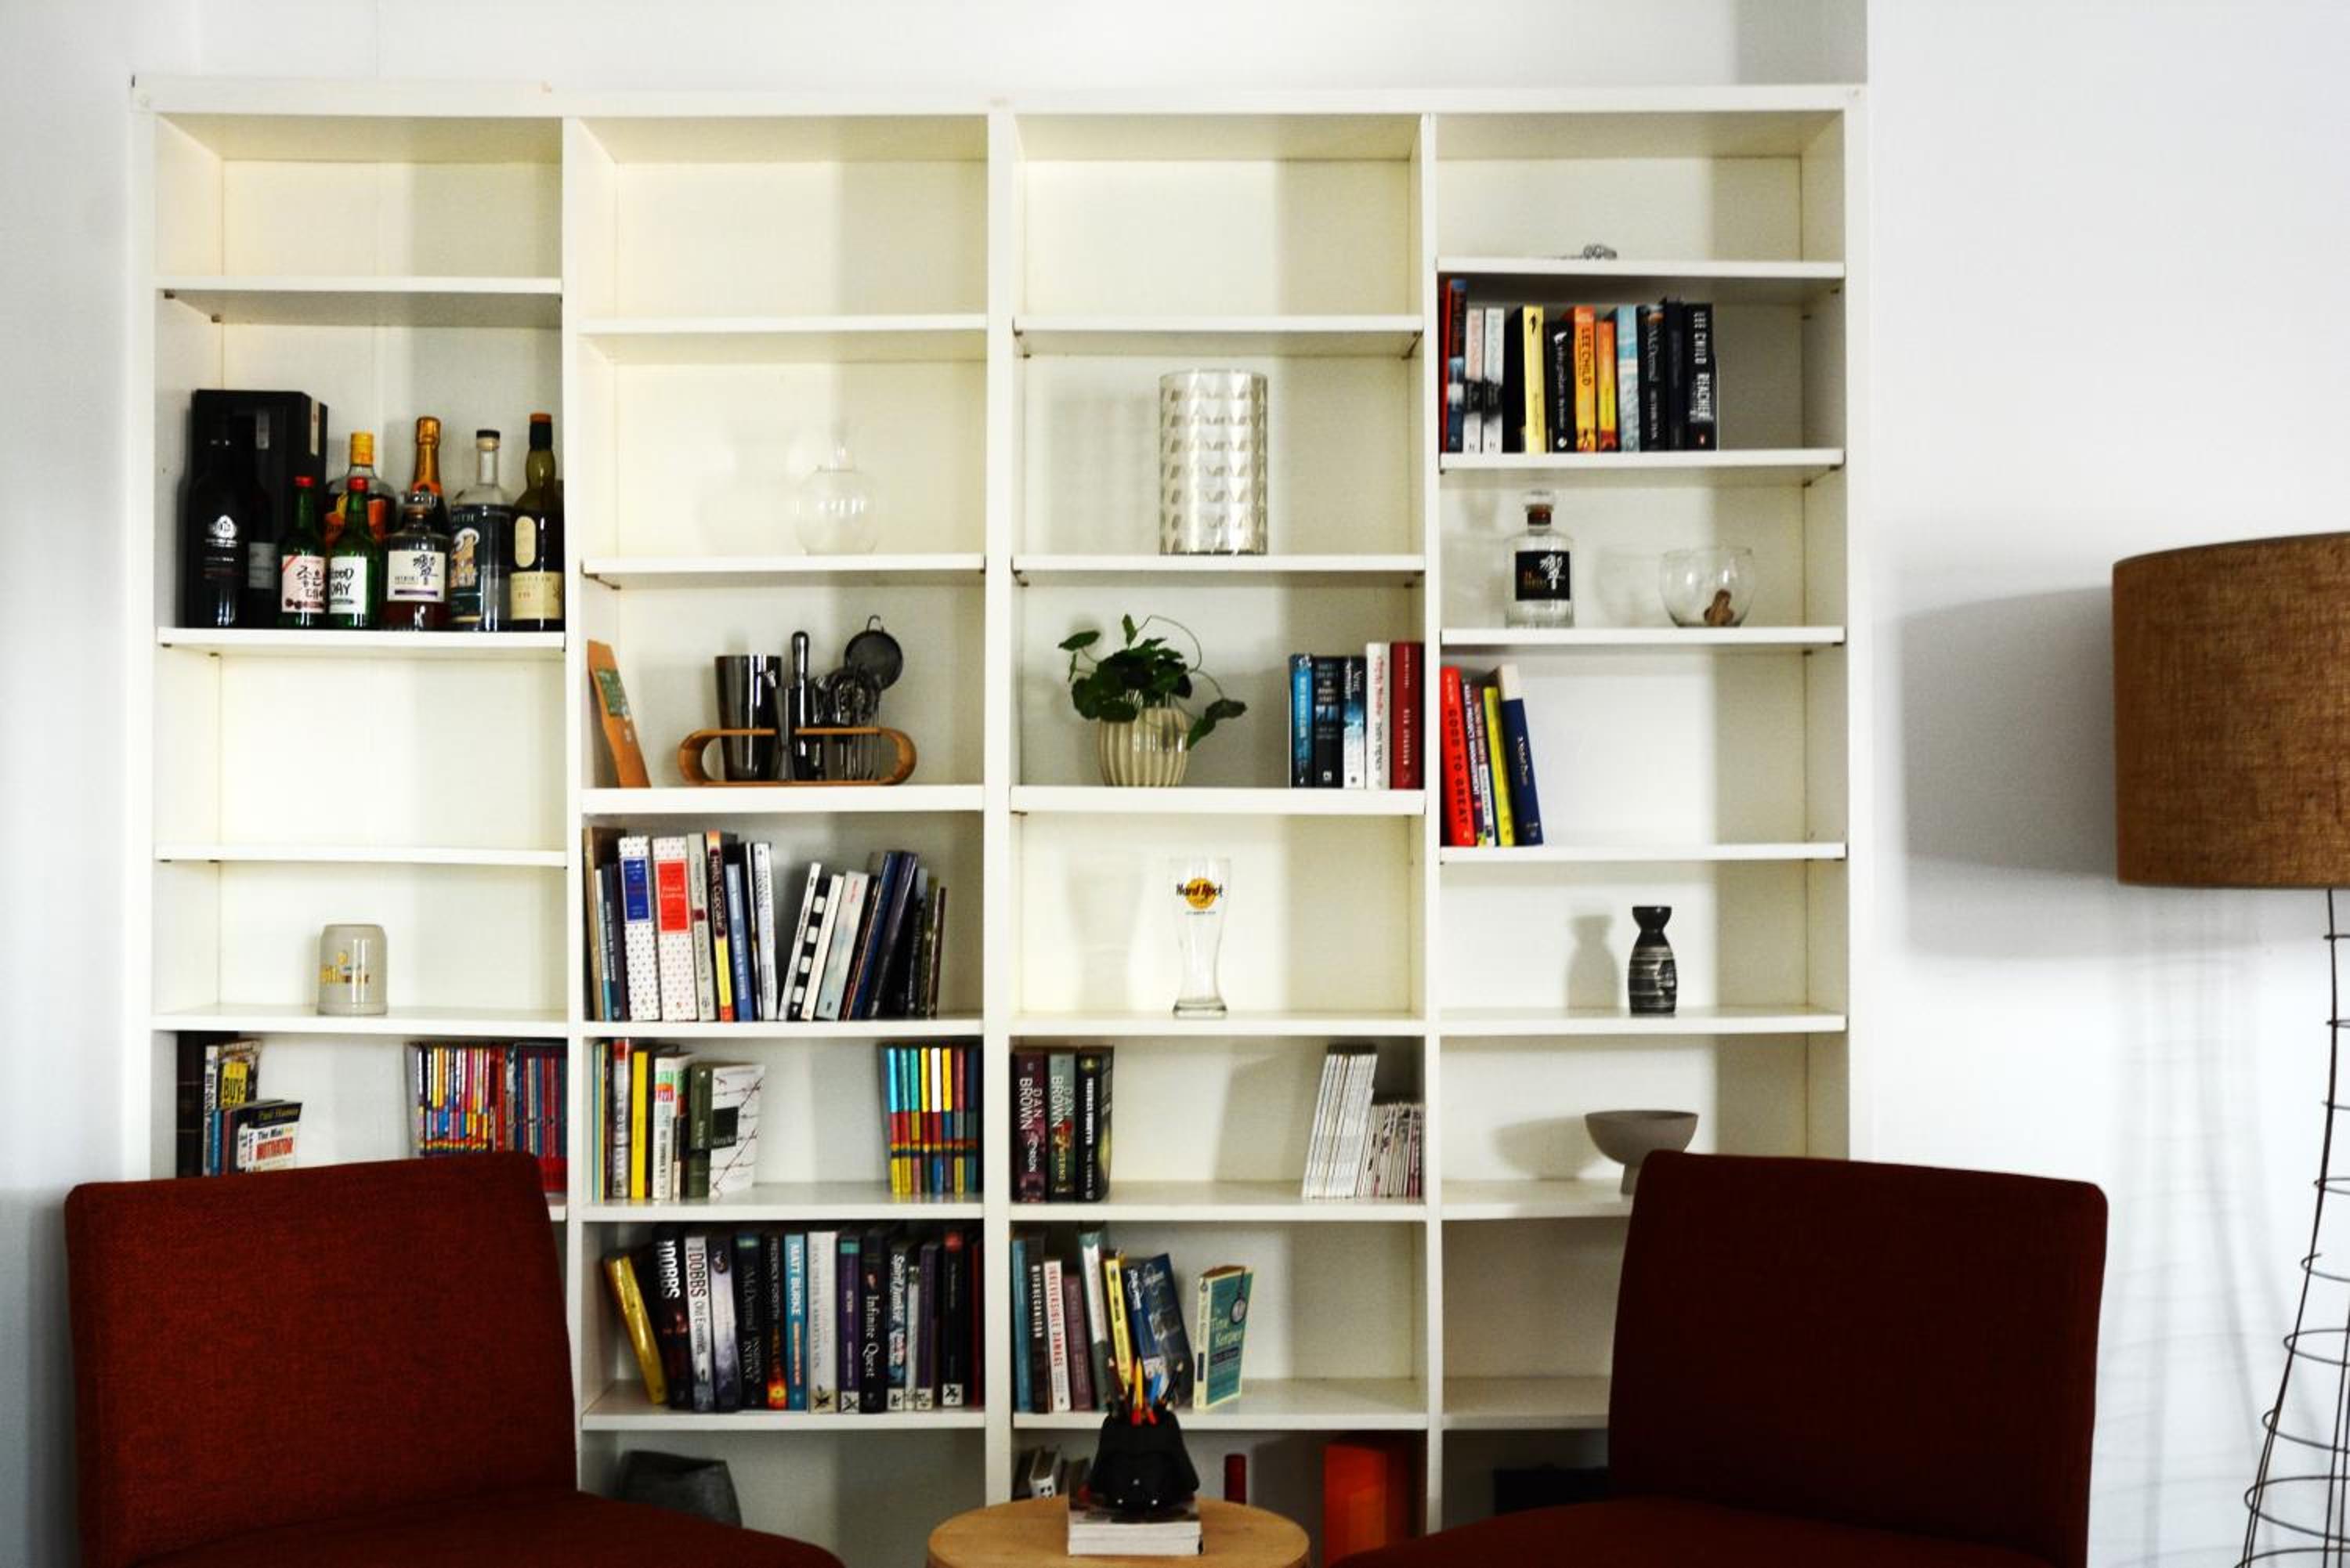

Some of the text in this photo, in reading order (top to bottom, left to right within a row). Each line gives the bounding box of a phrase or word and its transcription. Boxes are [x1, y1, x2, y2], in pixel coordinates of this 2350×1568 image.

[1581, 327, 1593, 386] LEE CHILD
[1693, 312, 1708, 364] LEE CHILD
[1447, 708, 1459, 748] GOOD
[1452, 754, 1462, 772] TO
[1455, 779, 1468, 826] GREAT
[1176, 883, 1200, 897] Hard
[1019, 1077, 1034, 1130] BROWN
[1033, 1087, 1043, 1118] DAN
[1051, 1075, 1065, 1129] BROWN
[1065, 1087, 1074, 1117] DAN
[656, 1247, 682, 1299] DOBBS
[689, 1252, 707, 1298] DOBBS
[862, 1294, 880, 1378] Infinite Quest
